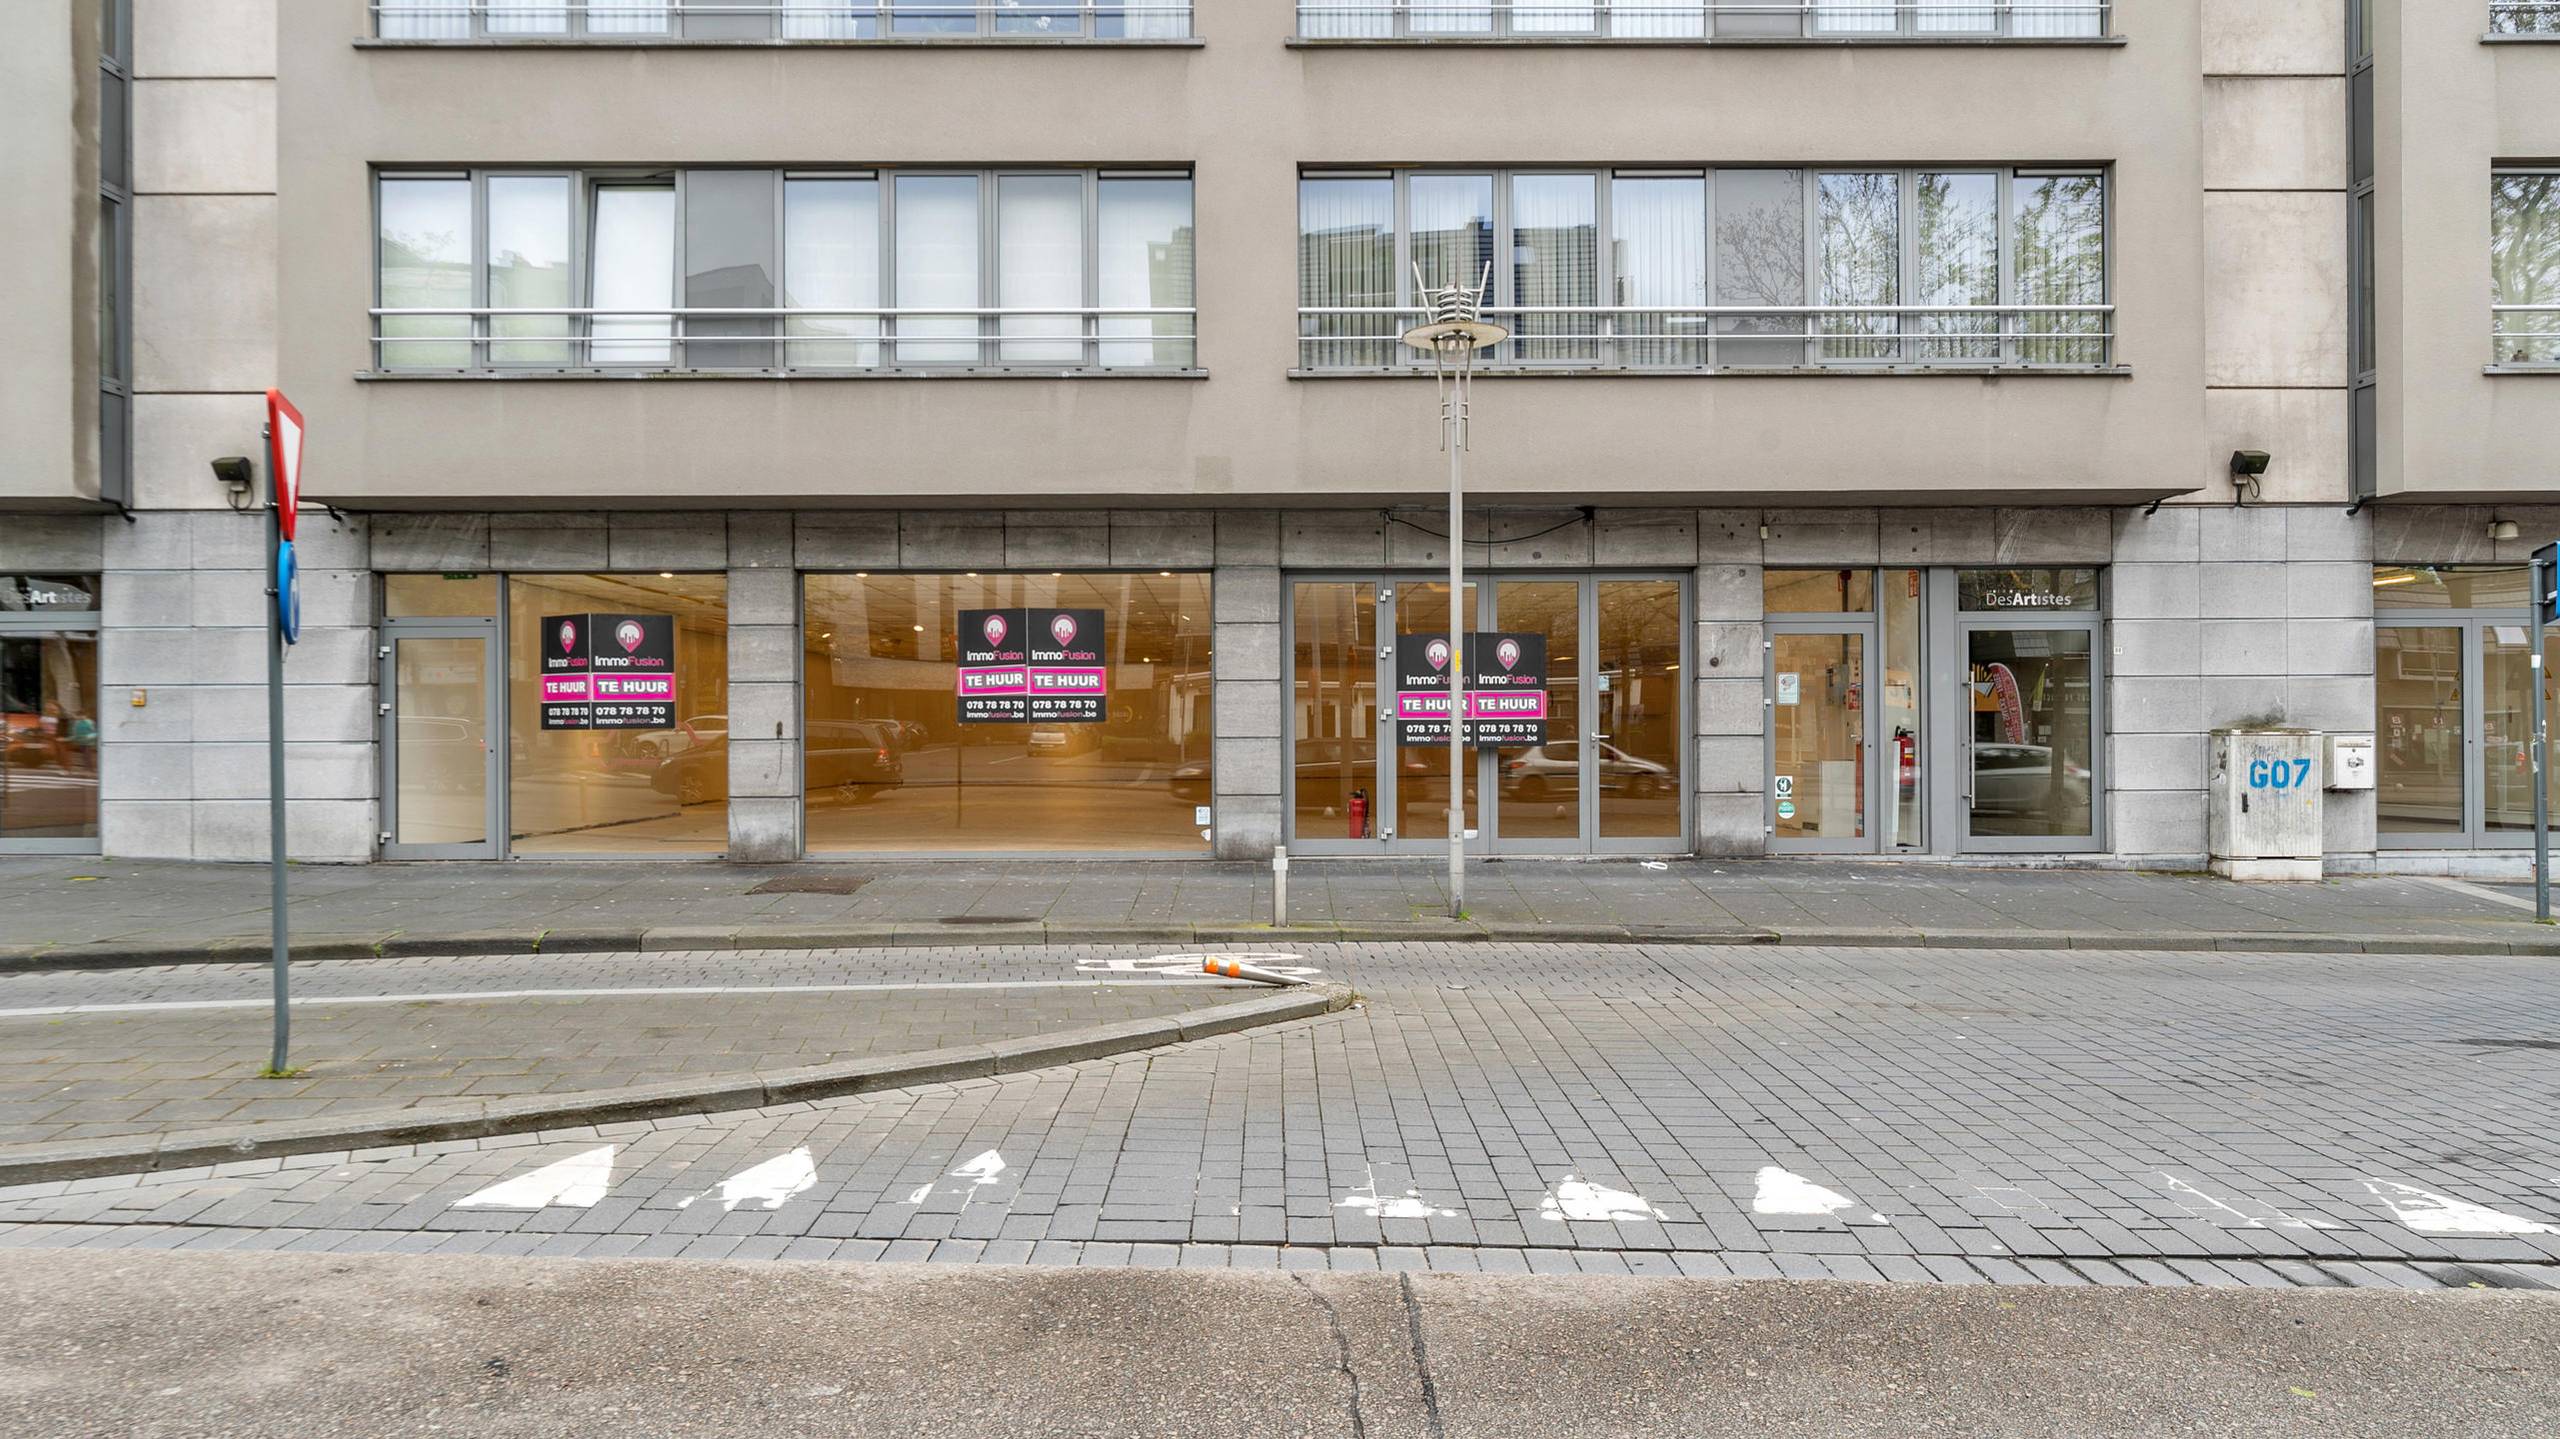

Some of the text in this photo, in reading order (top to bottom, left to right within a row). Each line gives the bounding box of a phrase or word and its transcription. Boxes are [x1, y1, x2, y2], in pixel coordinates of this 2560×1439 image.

[1986, 590, 2072, 606] DesArtistes
[967, 651, 1023, 660] ImmoFusion
[1032, 650, 1095, 660] ImmoFusion
[548, 657, 588, 667] ImmoFusion
[595, 656, 664, 666] ImmoFusion
[966, 673, 1023, 686] TE HUUR
[1034, 675, 1099, 686] TE HUUR
[1406, 675, 1470, 685] ImmoFun
[1479, 674, 1537, 684] ImmoFusion
[546, 682, 586, 692] TE HUUR
[598, 681, 668, 692] TE HUUR
[967, 701, 1025, 709] 078 78 78 70
[1033, 701, 1097, 709] 078 78 78 70
[1403, 699, 1421, 710] TE
[1478, 699, 1537, 709] TE HUUR
[549, 708, 589, 716] 078 78 78 70
[596, 707, 666, 715] 078 78 78 70
[1406, 725, 1425, 733] 078
[1428, 725, 1440, 733] 78
[2250, 758, 2311, 789] G07
